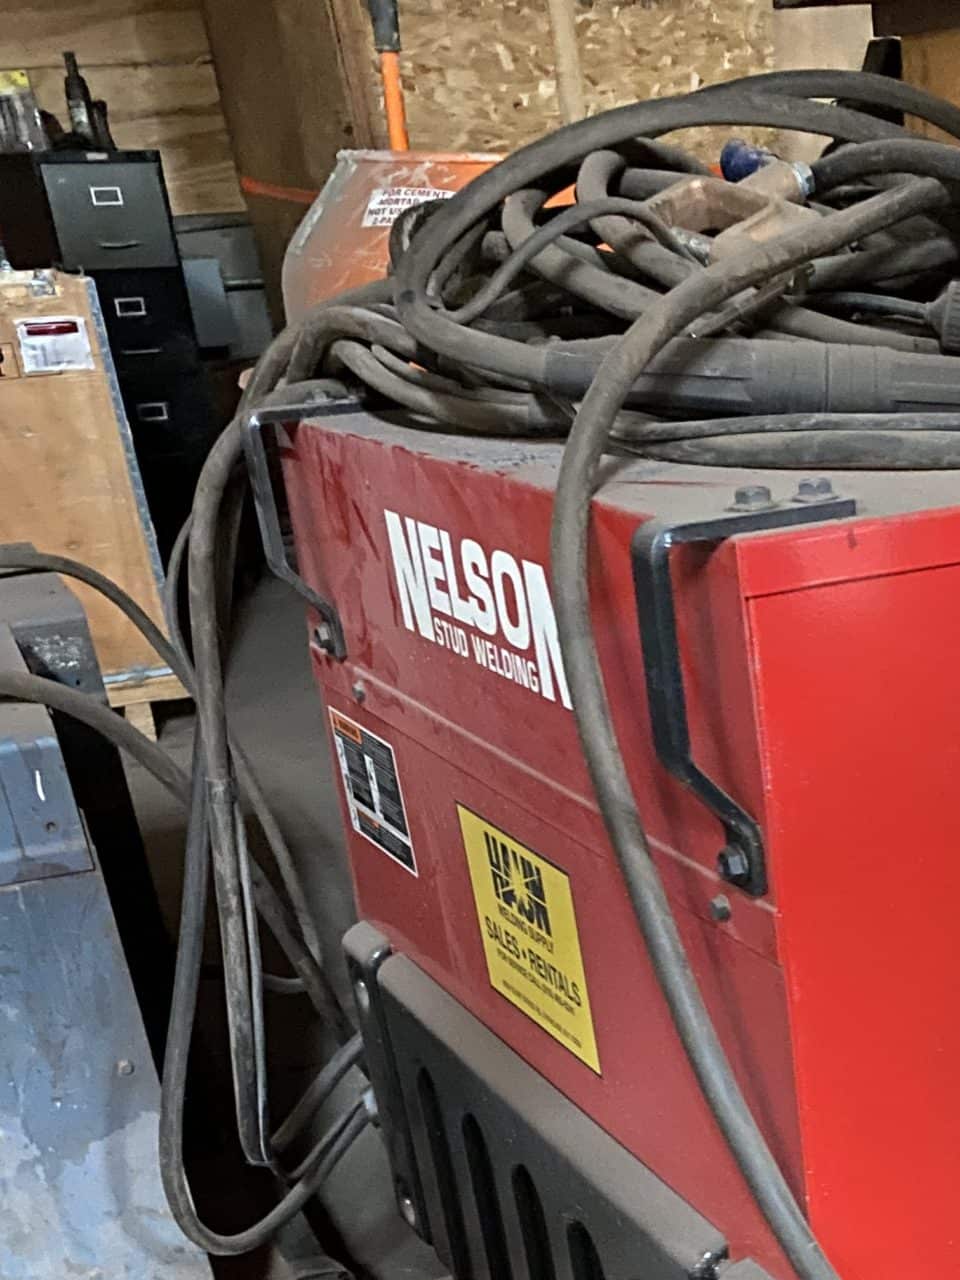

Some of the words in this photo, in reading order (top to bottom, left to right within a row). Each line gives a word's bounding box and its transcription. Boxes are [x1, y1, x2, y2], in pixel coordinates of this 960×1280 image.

[384, 509, 574, 711] NELSON
[433, 617, 469, 658] STUD
[471, 634, 540, 694] WELDING
[485, 916, 521, 961] SALES
[527, 947, 582, 1008] RENTALS
